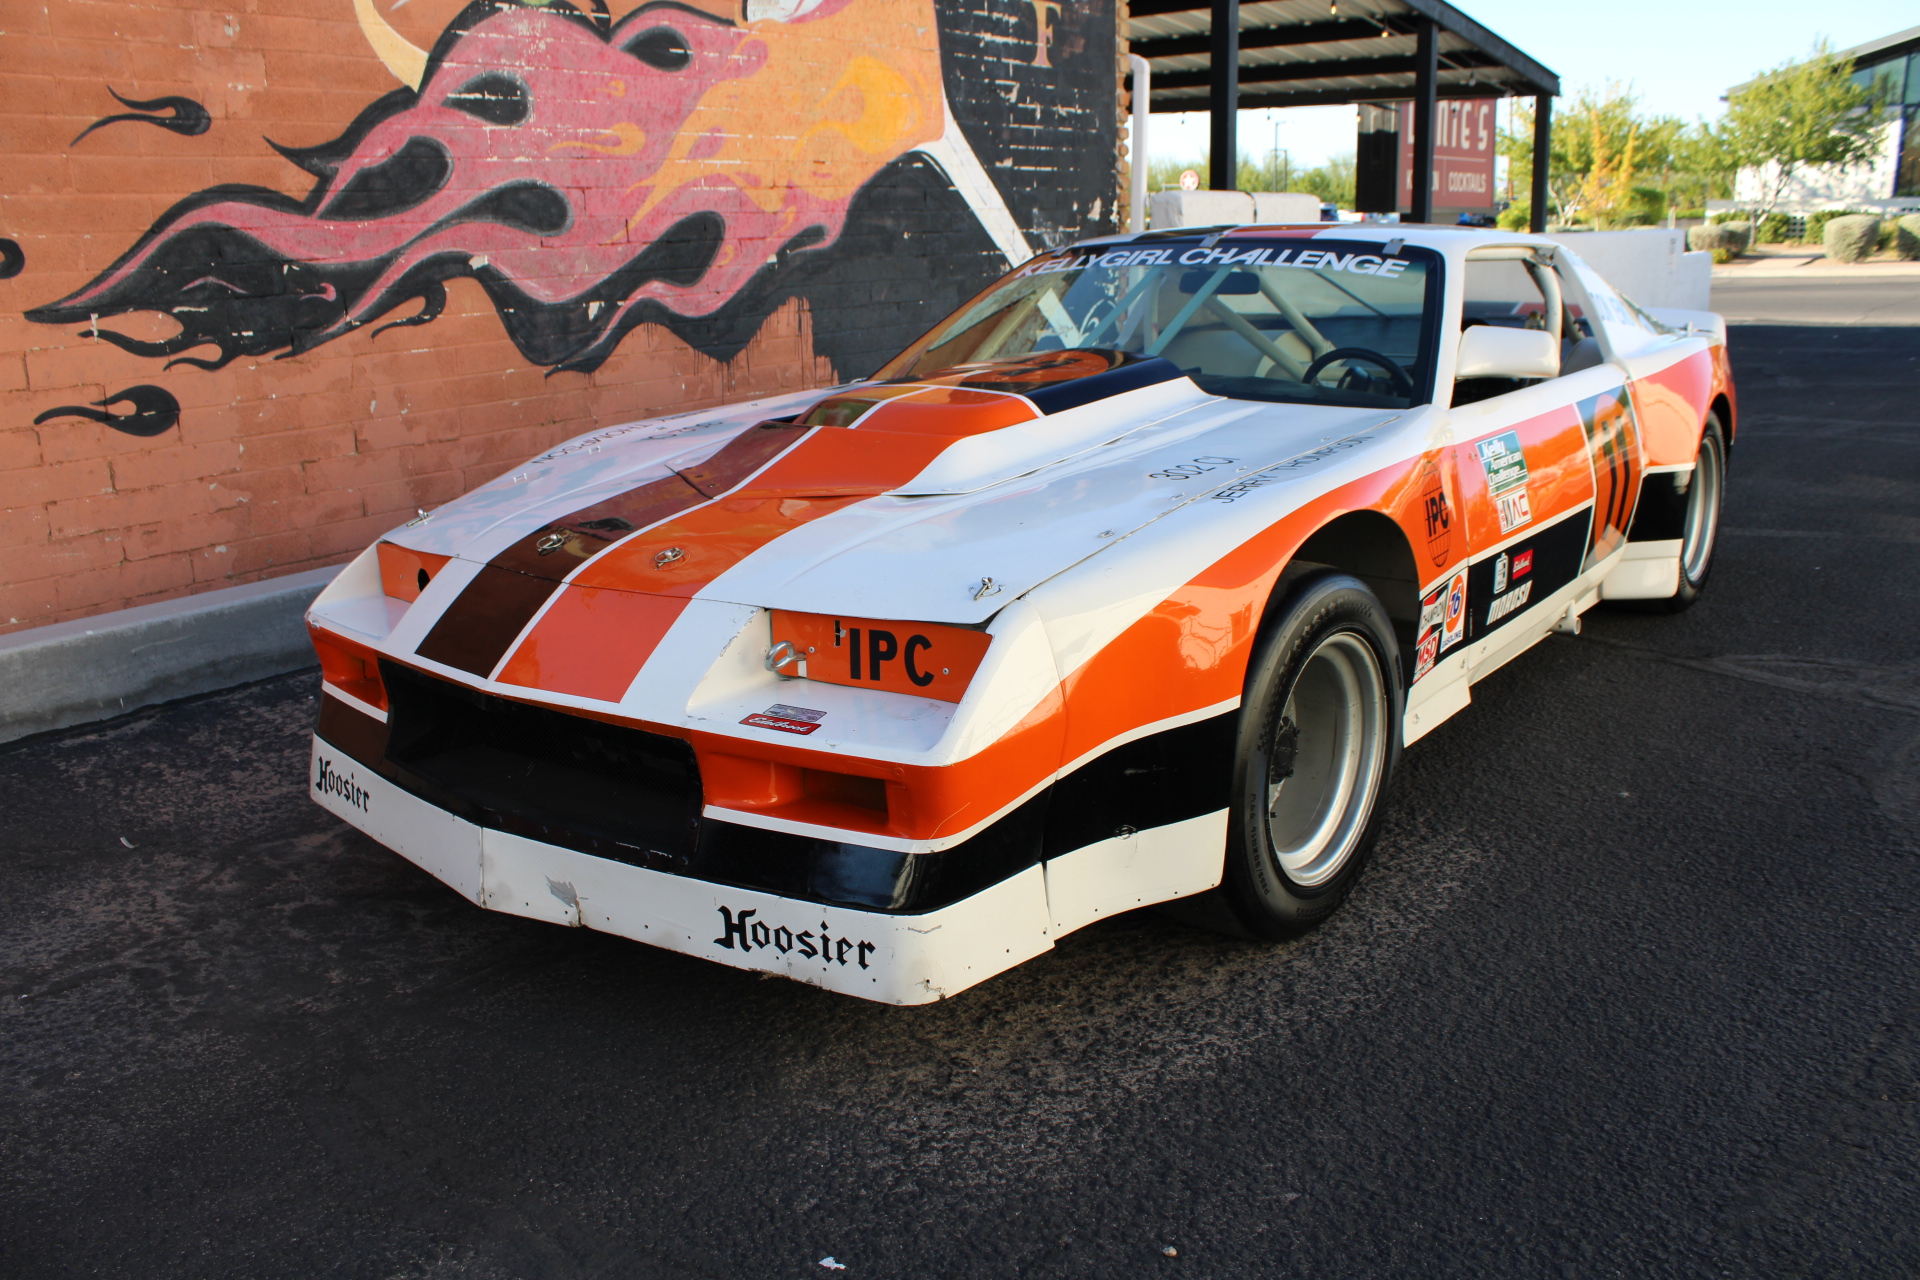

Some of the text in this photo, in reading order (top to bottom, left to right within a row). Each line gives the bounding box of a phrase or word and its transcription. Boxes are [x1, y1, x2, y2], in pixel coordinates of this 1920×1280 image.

[1448, 171, 1487, 193] COCKTAILS
[1178, 247, 1410, 279] CHALLENGE
[1481, 439, 1508, 458] Kelly
[1490, 451, 1522, 470] American
[1148, 464, 1218, 481] 302
[1211, 436, 1375, 504] JERRY THOMPSON
[1425, 492, 1449, 537] IPC
[1447, 582, 1463, 622] 76
[1416, 636, 1438, 671] MSD
[1441, 629, 1463, 649] GASOLINE
[848, 627, 935, 687] IPC
[315, 755, 370, 814] Hoosier
[713, 905, 876, 970] Hoosier
